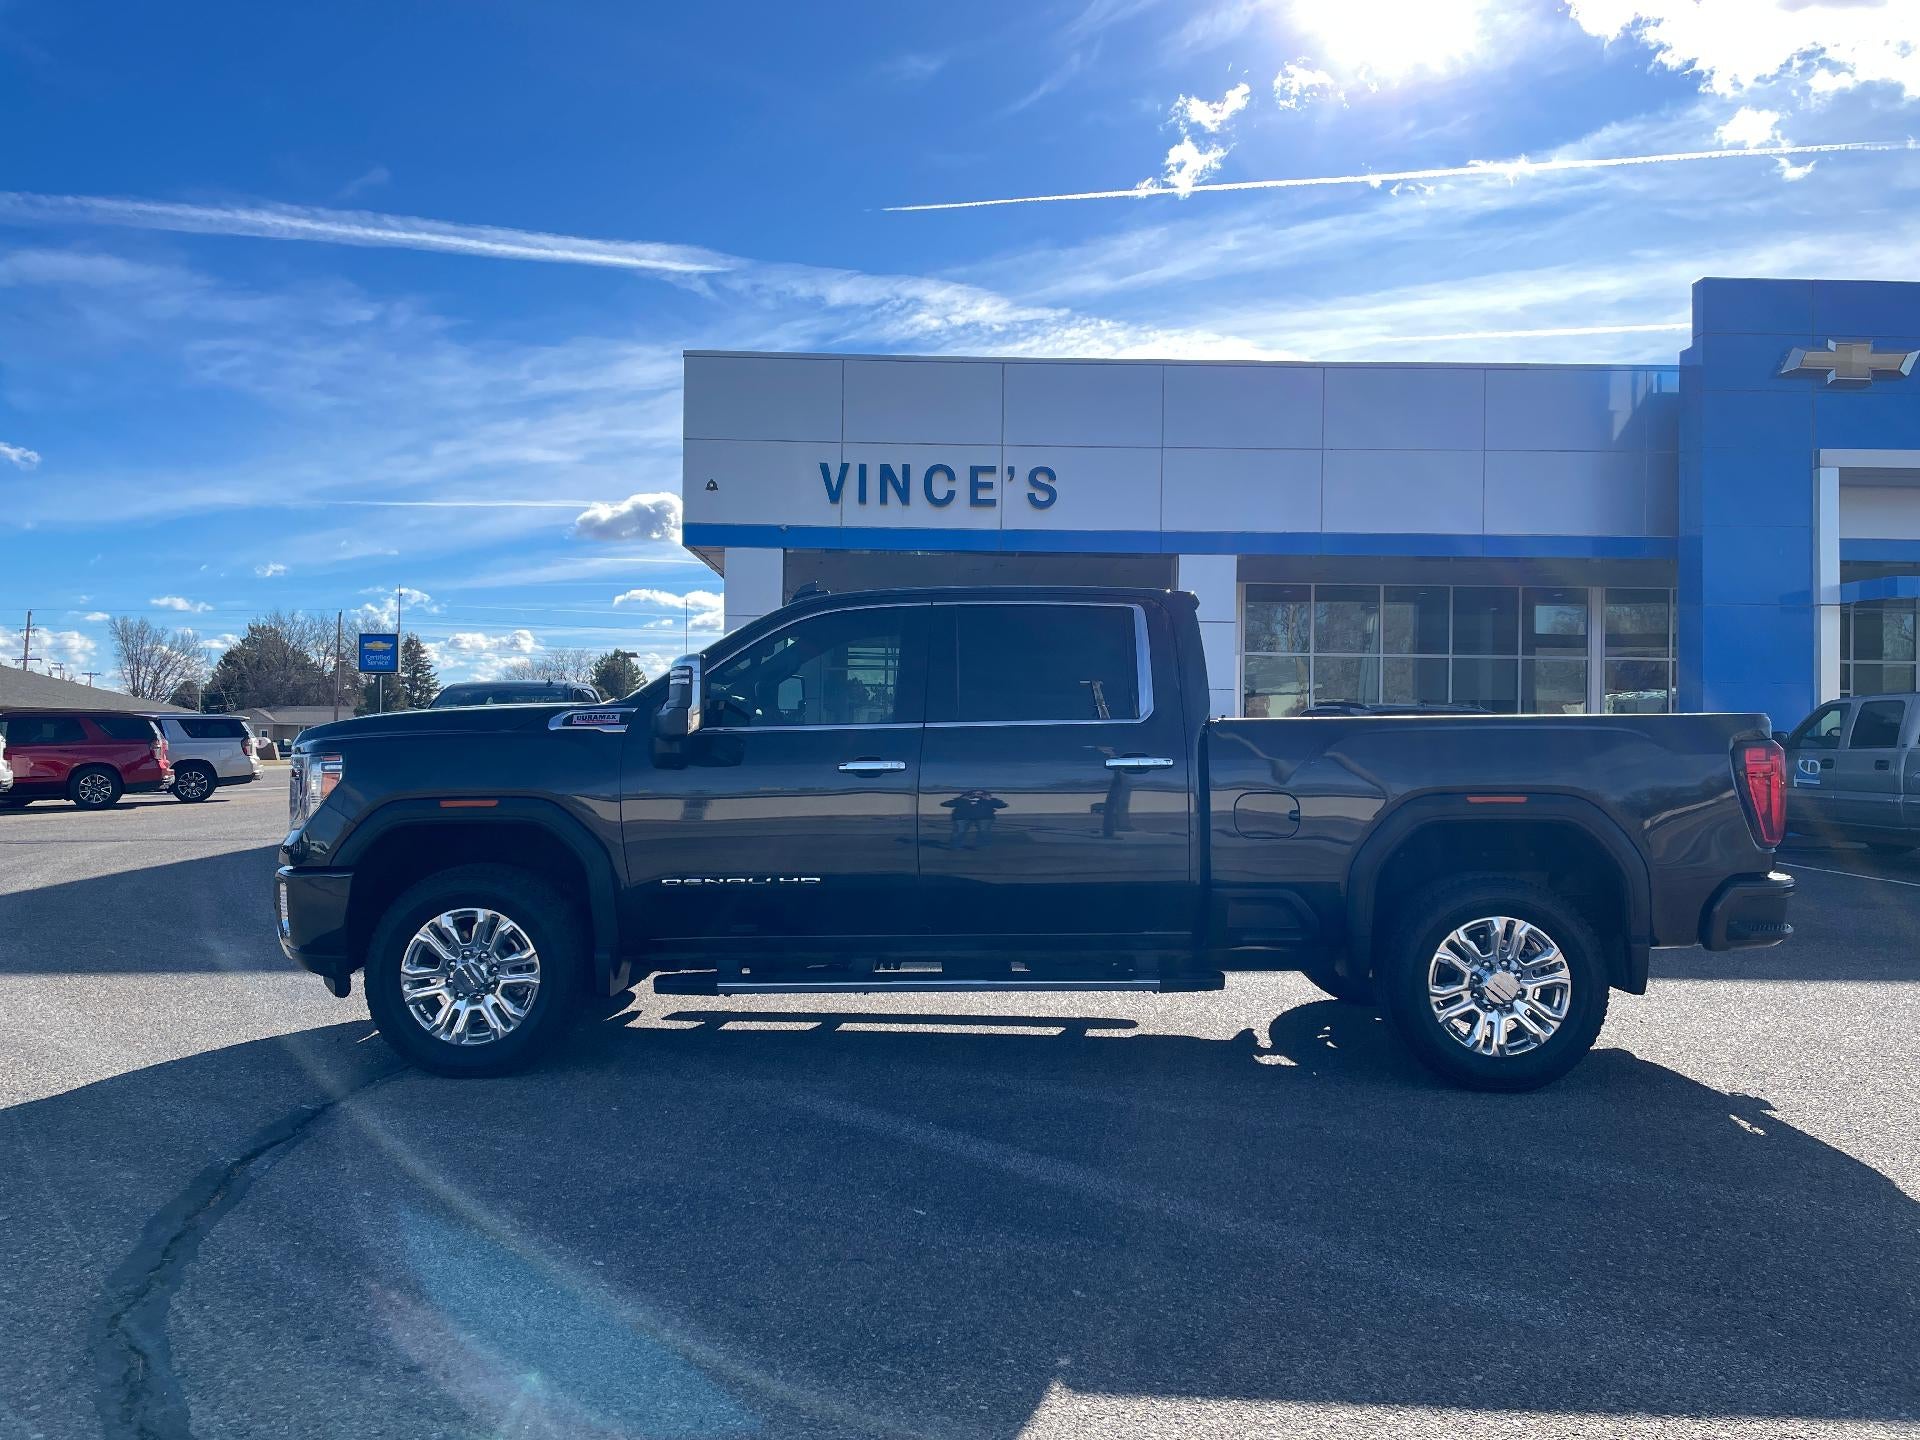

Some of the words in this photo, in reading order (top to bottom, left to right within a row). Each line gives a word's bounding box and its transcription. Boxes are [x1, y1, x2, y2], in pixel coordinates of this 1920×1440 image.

[819, 462, 1058, 510] VINCE'S
[365, 654, 391, 662] Certified
[576, 713, 617, 721] DURAMAX
